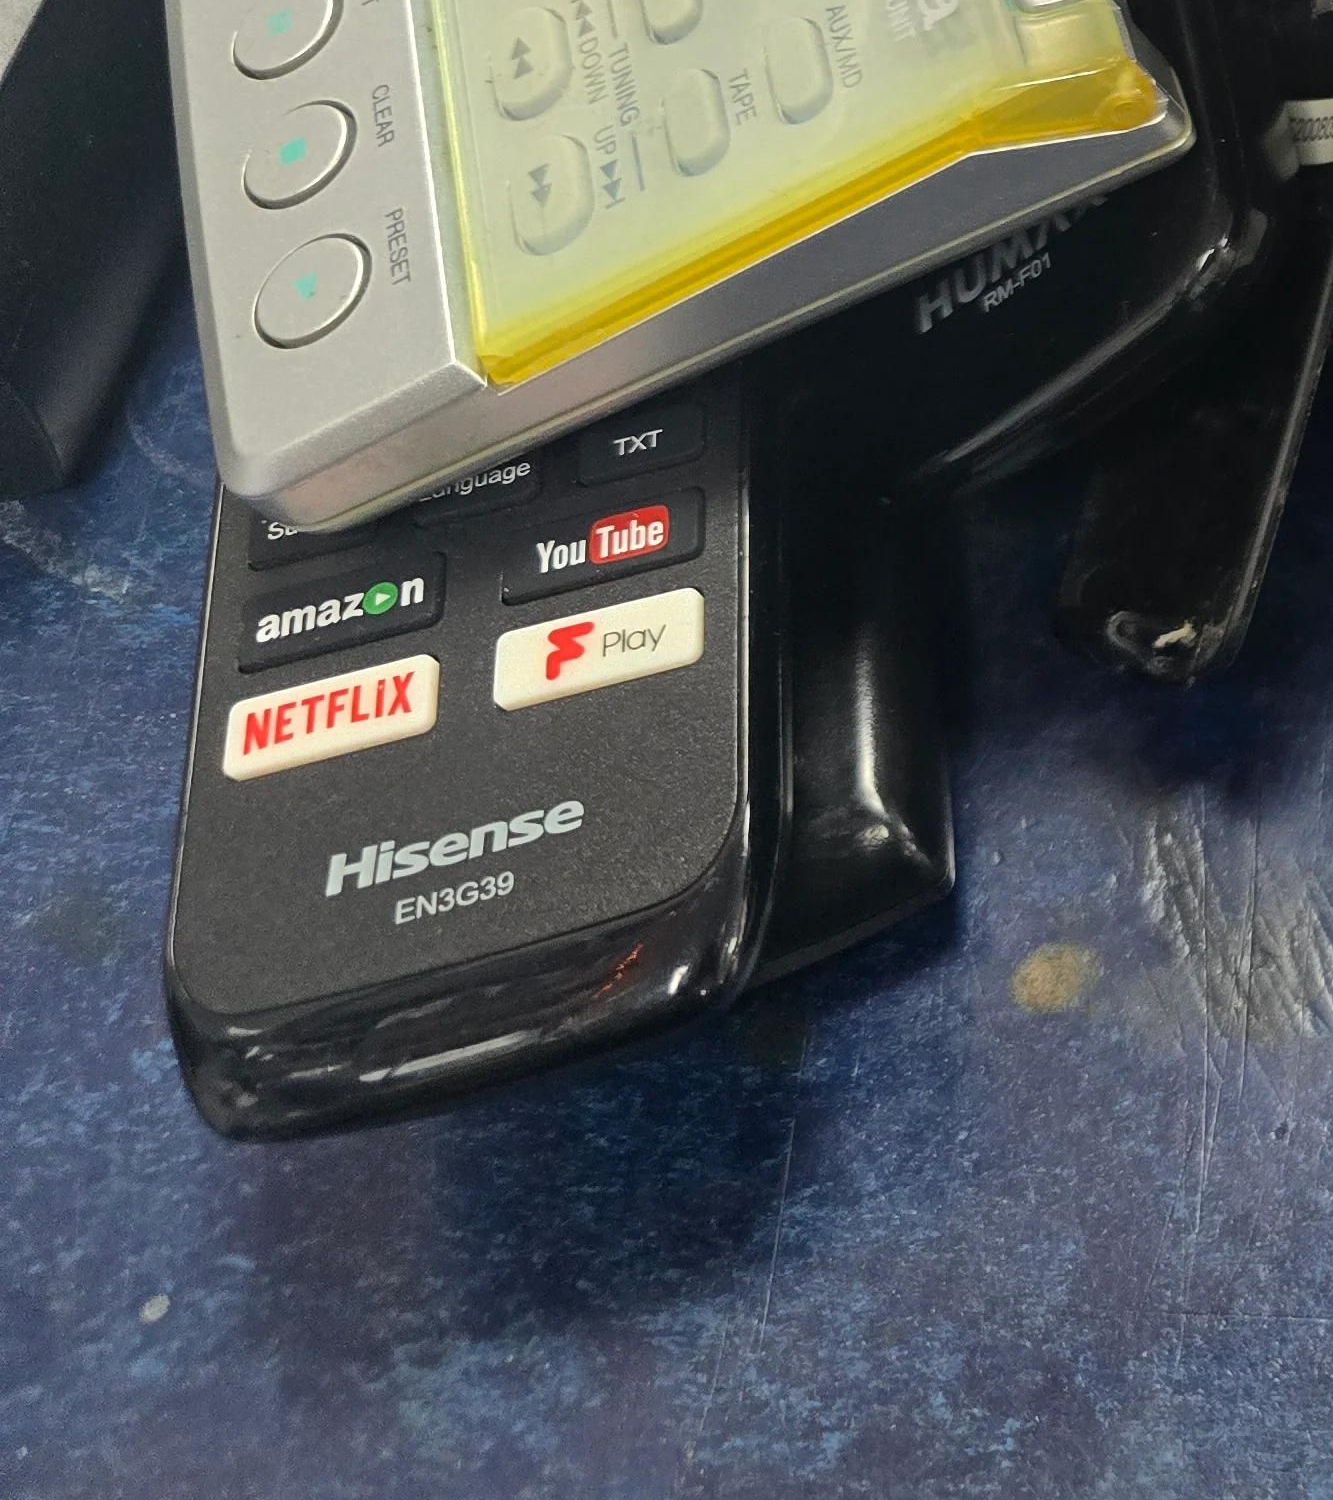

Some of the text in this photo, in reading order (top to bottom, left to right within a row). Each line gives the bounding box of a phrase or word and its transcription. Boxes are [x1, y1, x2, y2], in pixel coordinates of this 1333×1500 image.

[826, 4, 863, 89] AUX/MD
[372, 84, 395, 147] CLEAR
[579, 38, 617, 155] DOWN UP
[608, 42, 640, 127] TUNING
[727, 70, 757, 123] TAPE
[384, 208, 412, 286] PRESET
[982, 252, 1054, 312] RM-F01
[613, 428, 664, 457] TXT
[419, 459, 531, 502] nguage
[536, 512, 667, 575] YouTube
[602, 623, 667, 659] Play
[242, 670, 416, 756] NETFLIX
[324, 798, 586, 898] Hisense
[394, 870, 516, 925] EN3G39
